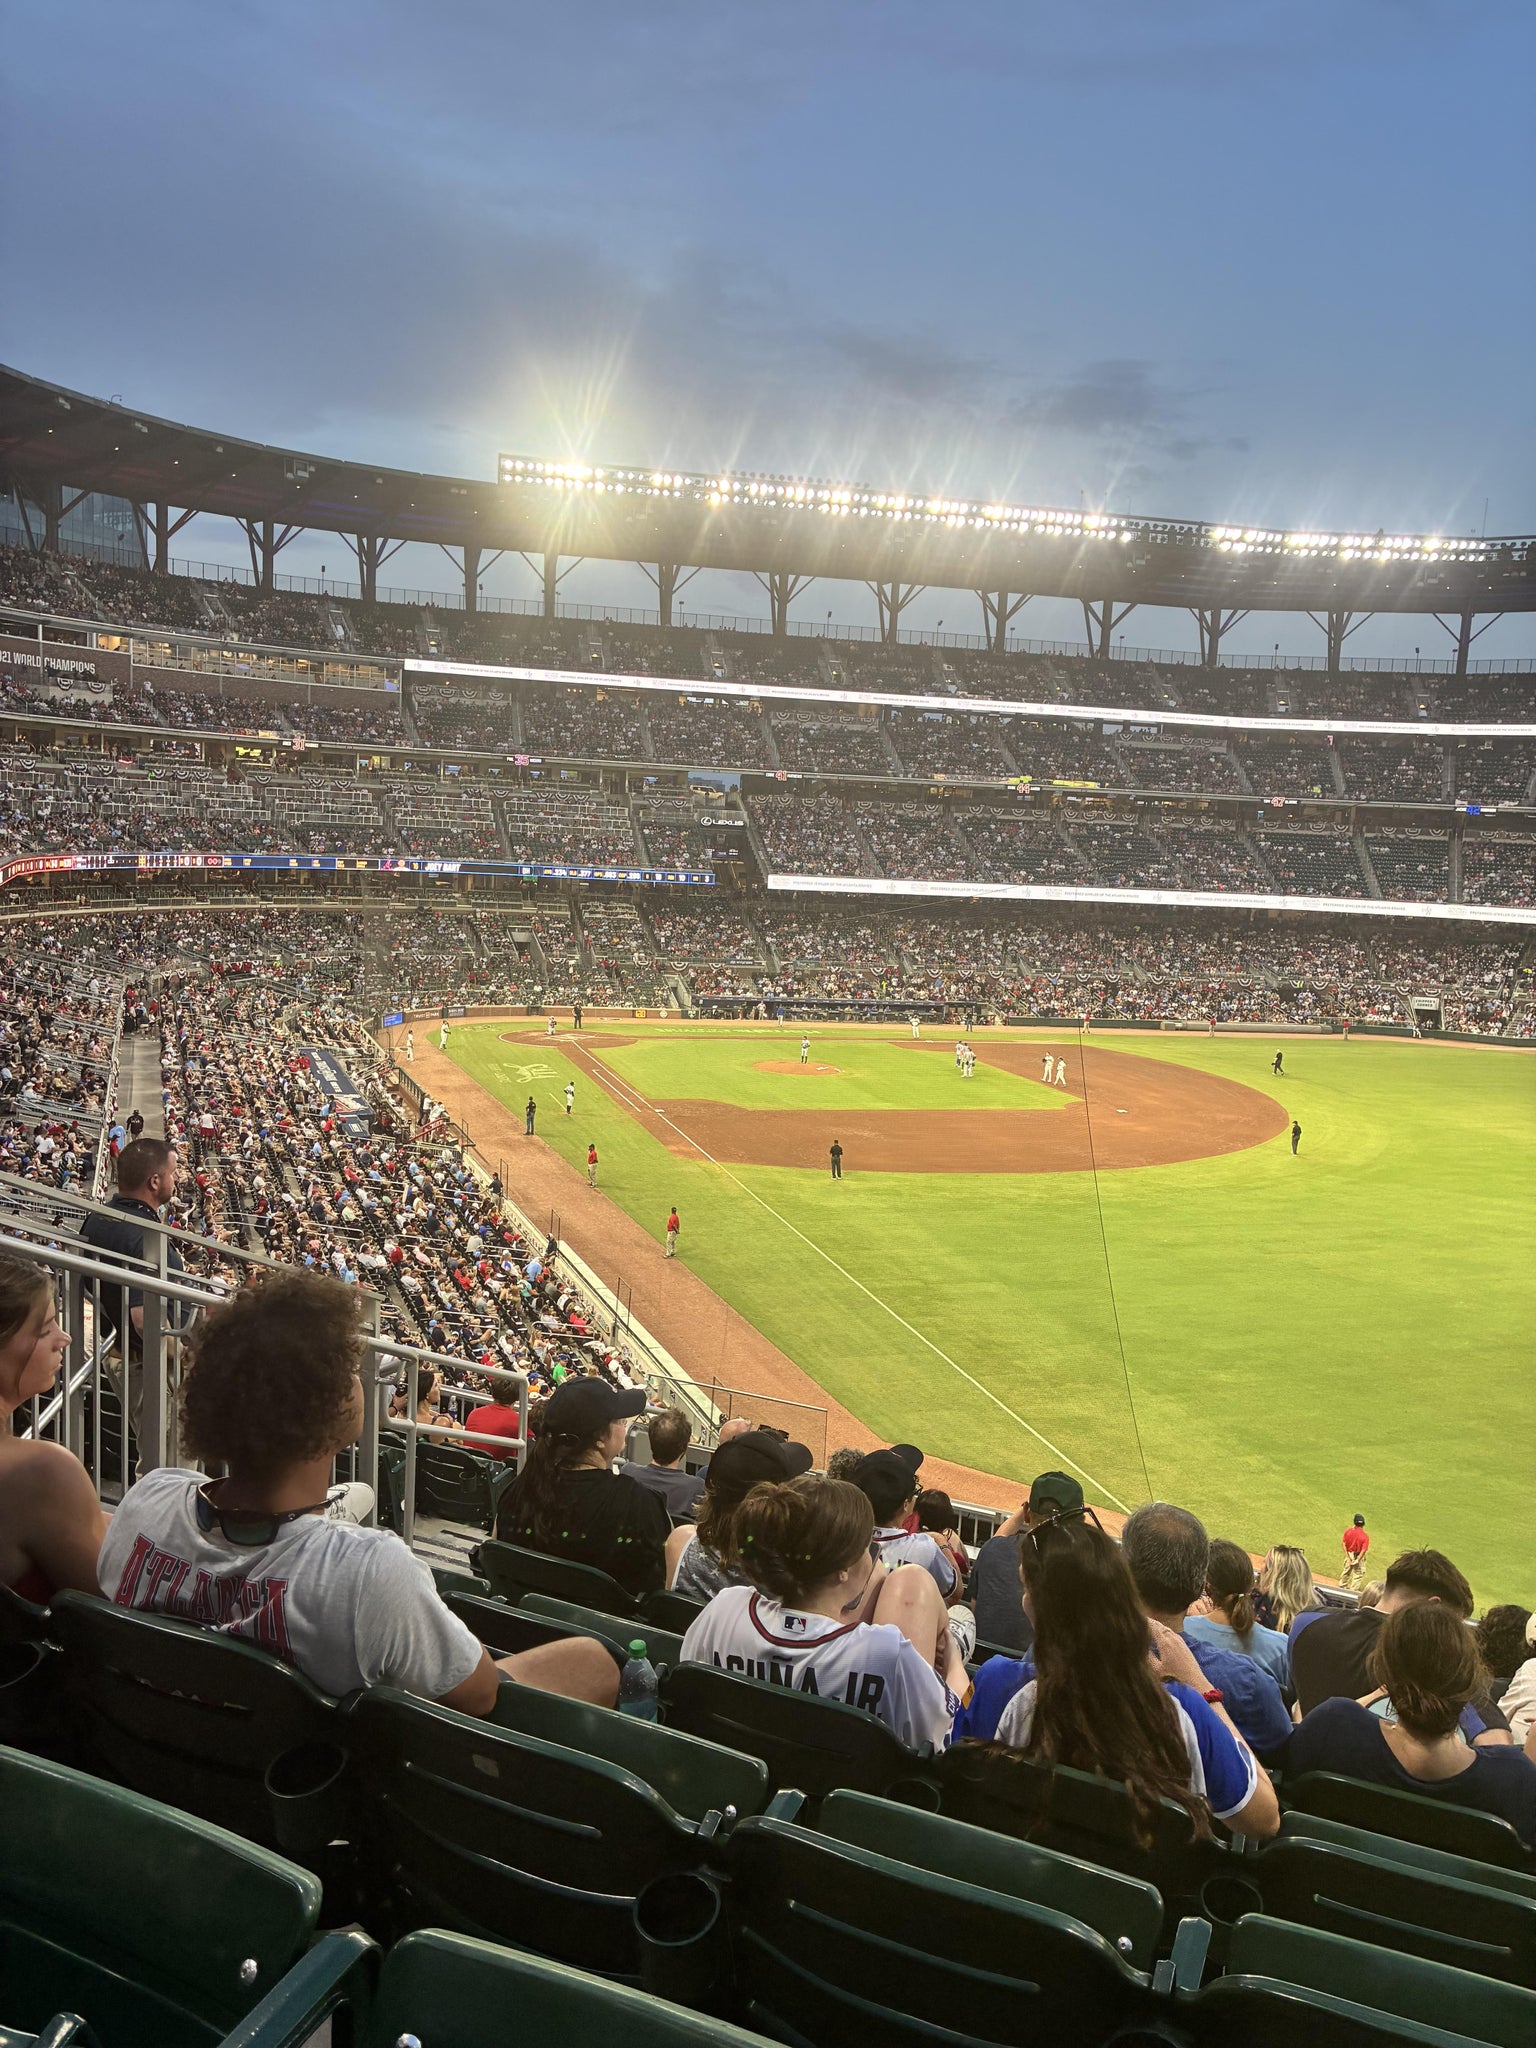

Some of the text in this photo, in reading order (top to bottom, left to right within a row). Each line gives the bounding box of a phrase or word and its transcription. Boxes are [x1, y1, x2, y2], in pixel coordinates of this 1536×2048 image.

[0, 649, 96, 674] 21 WORLD CHAMPIONS
[515, 754, 530, 766] 35
[1017, 783, 1031, 794] 44
[1270, 796, 1286, 807] 47
[114, 1533, 296, 1664] ATLANTA
